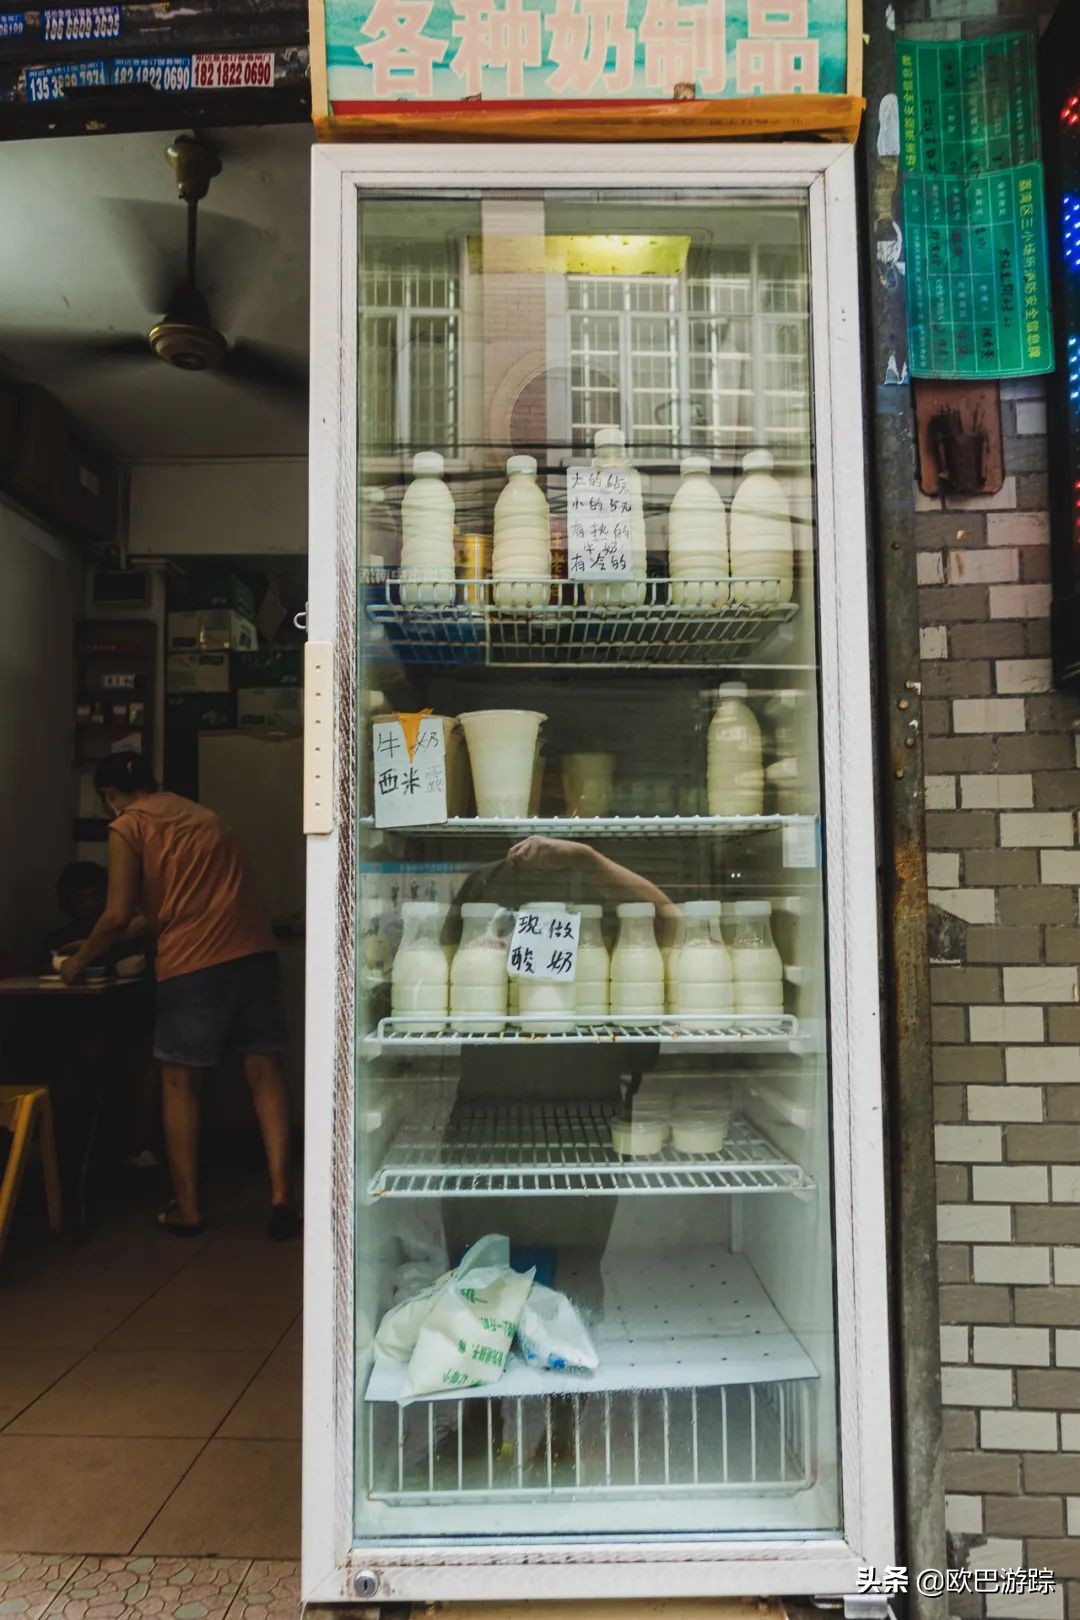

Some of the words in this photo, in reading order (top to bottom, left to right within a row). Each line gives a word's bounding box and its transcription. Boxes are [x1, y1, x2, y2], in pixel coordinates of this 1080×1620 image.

[355, 0, 820, 97] 各种奶制品
[114, 67, 133, 84] 182
[163, 66, 190, 90] 0690
[194, 62, 214, 86] 182
[217, 62, 242, 86] 1822
[244, 61, 271, 85] 0690
[30, 76, 50, 101] 135
[572, 496, 632, 514] 小的5元
[571, 553, 627, 573] 有冷的
[377, 731, 439, 758] 牛奶
[518, 914, 575, 940] 现做
[511, 946, 573, 975] 酸奶
